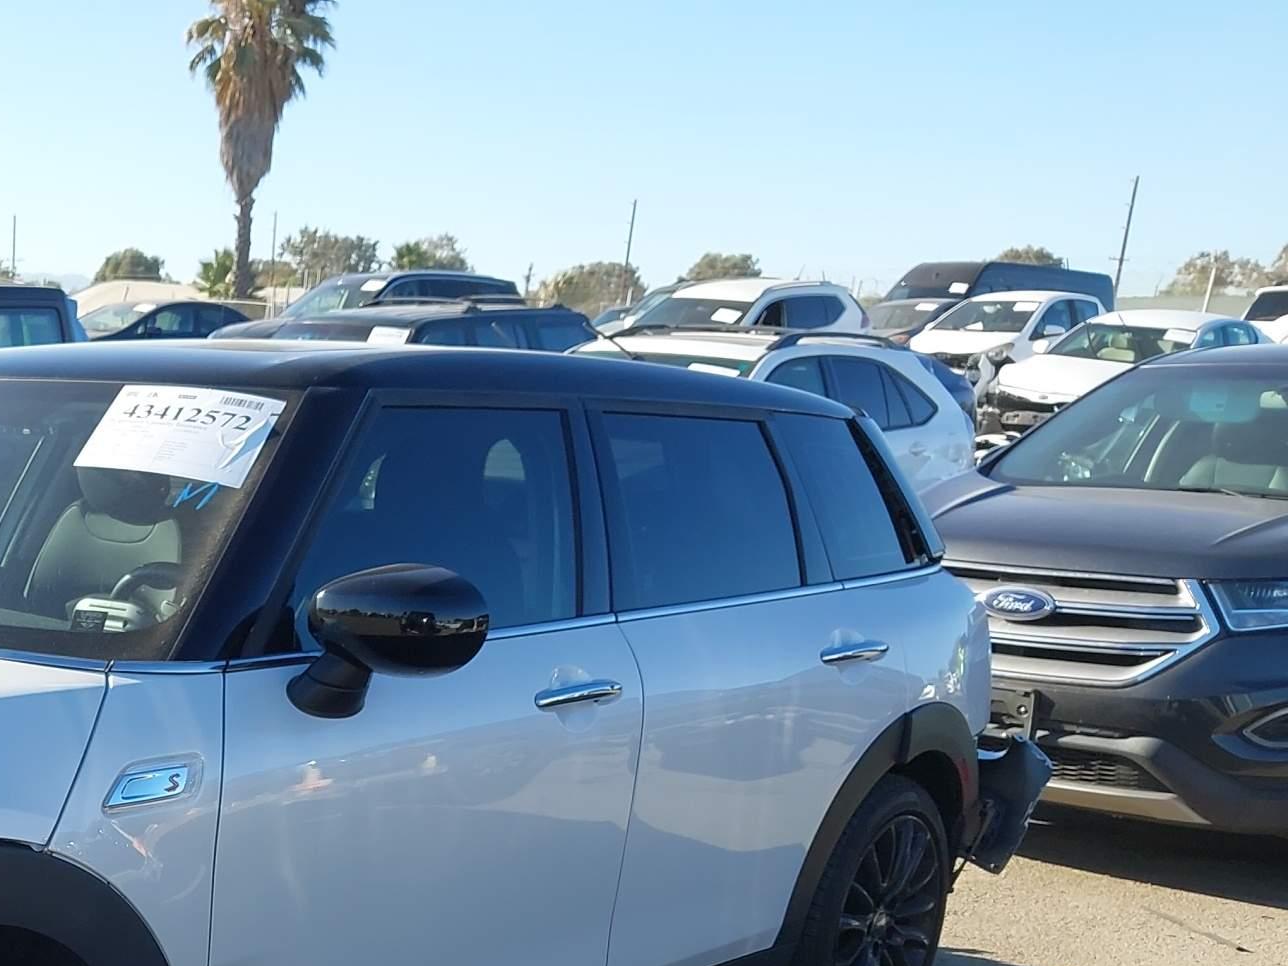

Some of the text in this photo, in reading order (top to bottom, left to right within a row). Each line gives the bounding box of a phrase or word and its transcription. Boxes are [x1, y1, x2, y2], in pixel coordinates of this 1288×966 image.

[123, 404, 252, 431] 43412572
[992, 593, 1035, 612] Ford
[164, 773, 181, 792] S
